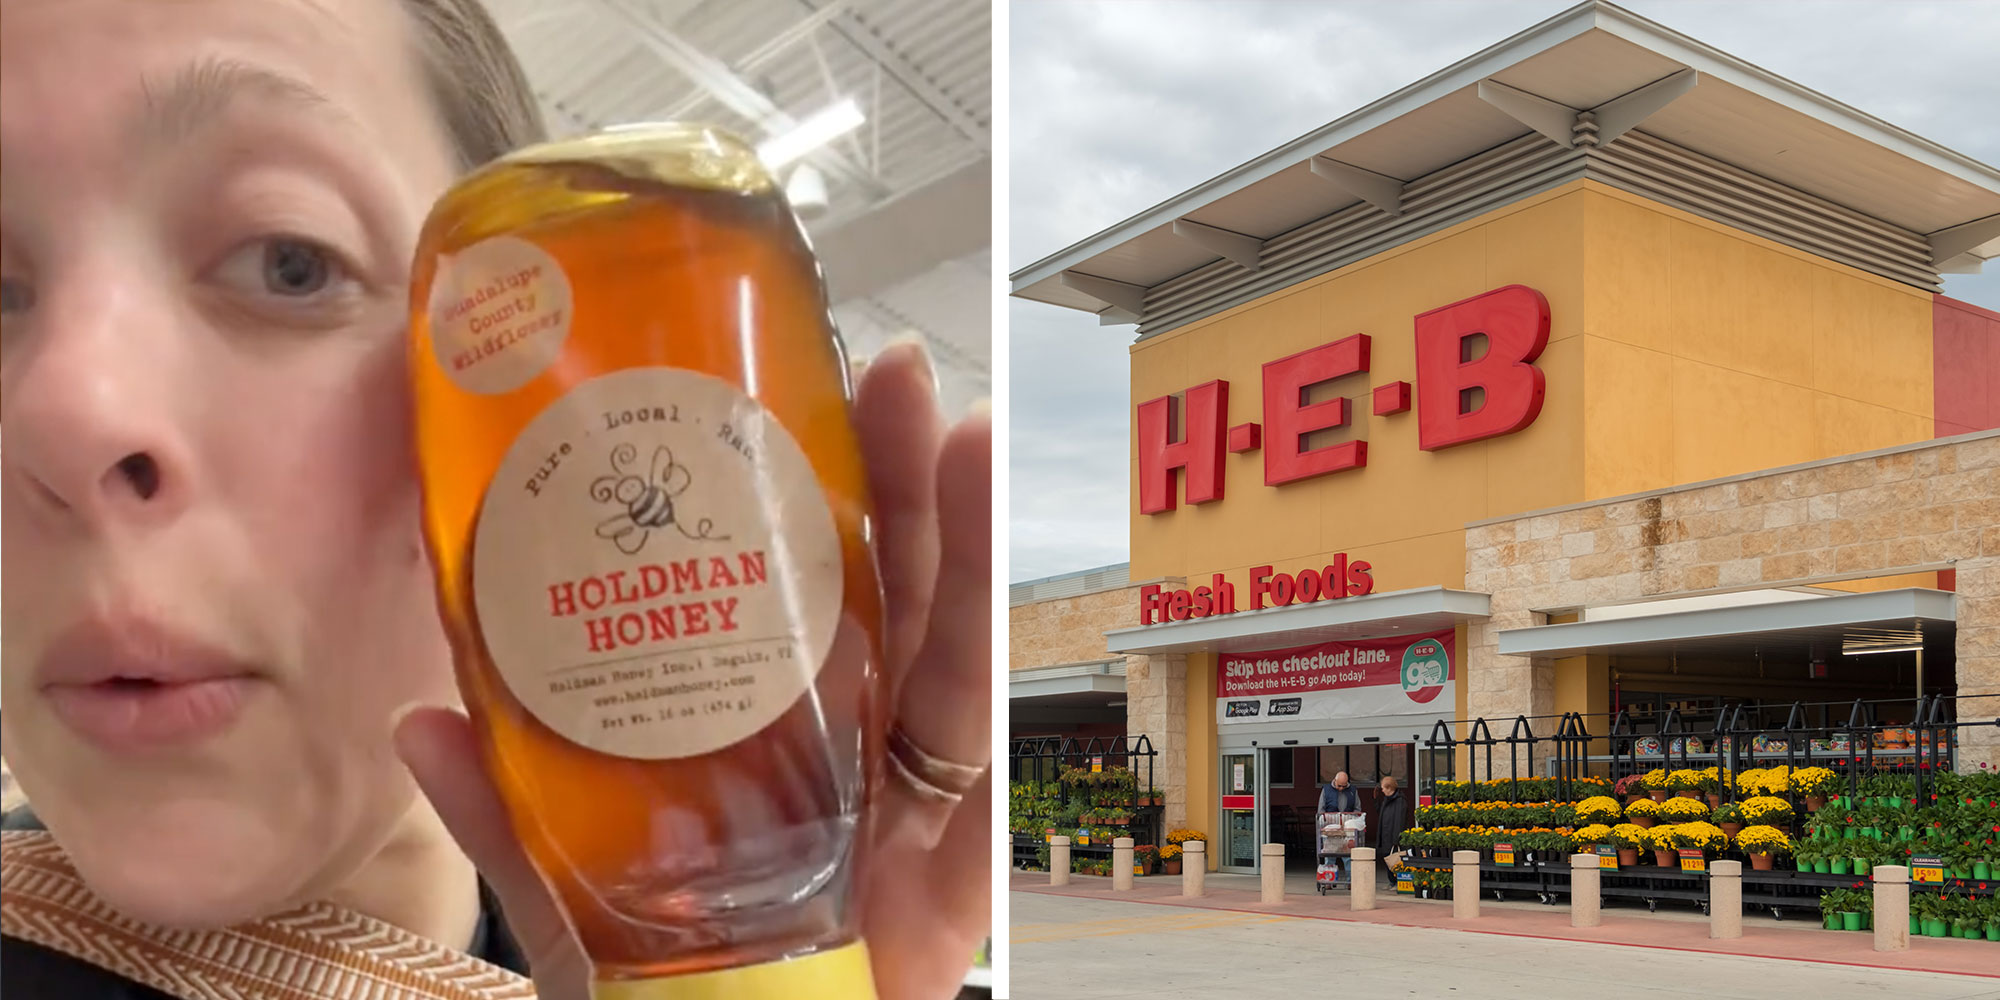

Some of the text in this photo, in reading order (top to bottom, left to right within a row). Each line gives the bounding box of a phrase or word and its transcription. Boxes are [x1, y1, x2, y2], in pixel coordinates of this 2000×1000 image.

[469, 293, 535, 334] County
[452, 309, 562, 371] Wildflower
[1137, 284, 1551, 516] H-E-B
[525, 442, 572, 498] Pure
[603, 405, 681, 430] Local
[548, 550, 768, 617] HOLDMAN
[1140, 553, 1374, 626] Fresh Foods
[585, 597, 739, 652] HONEY
[549, 675, 606, 694] Holdman
[611, 667, 653, 682] Honey
[1226, 648, 1390, 679] Skip the checkout lane.
[1226, 669, 1366, 691] Download the H-E-B go App today!
[1406, 660, 1442, 691] go
[594, 675, 755, 707] www.holdmanhoney.com
